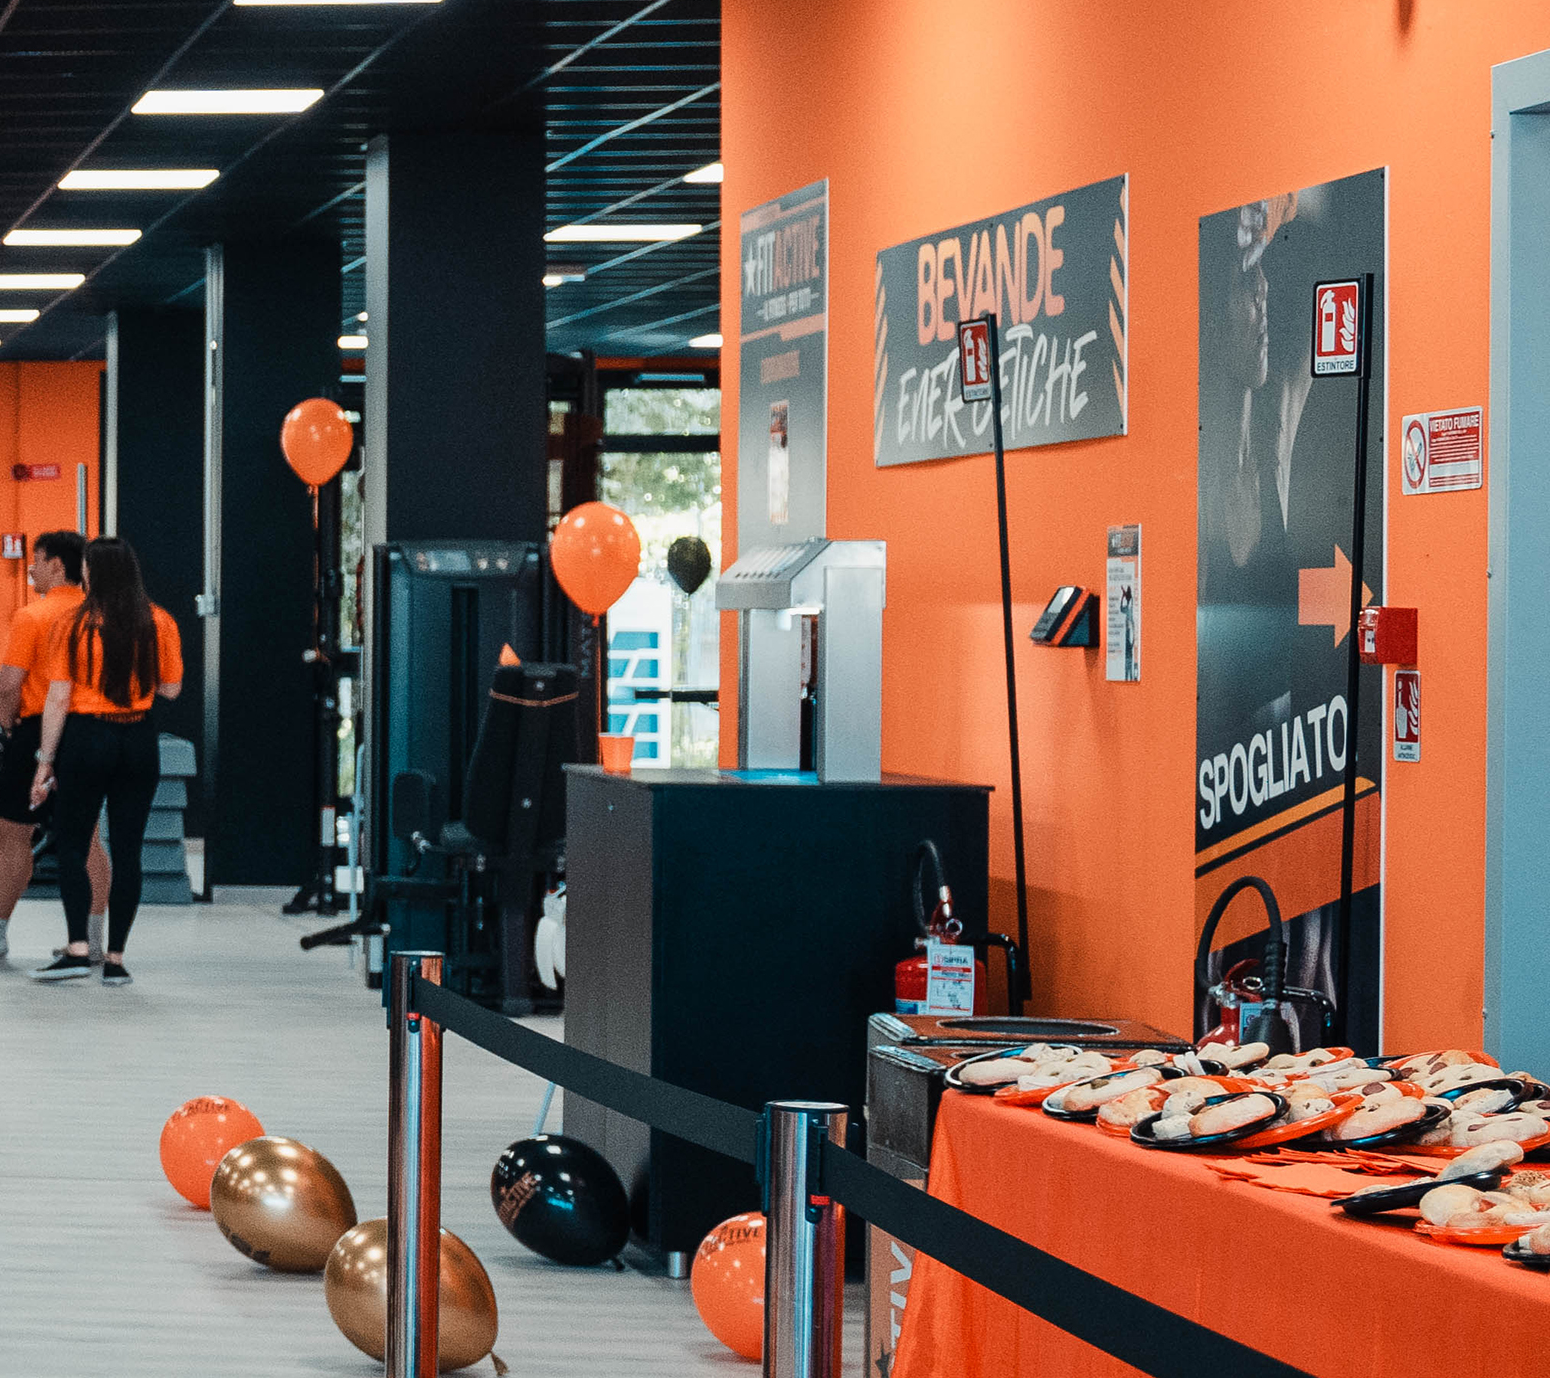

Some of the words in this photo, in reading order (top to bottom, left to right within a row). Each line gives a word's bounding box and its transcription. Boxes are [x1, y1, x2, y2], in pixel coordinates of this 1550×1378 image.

[917, 205, 1066, 346] BEVANDE
[1317, 360, 1355, 372] ESTINTORE
[1198, 695, 1349, 830] SPOGLIATO
